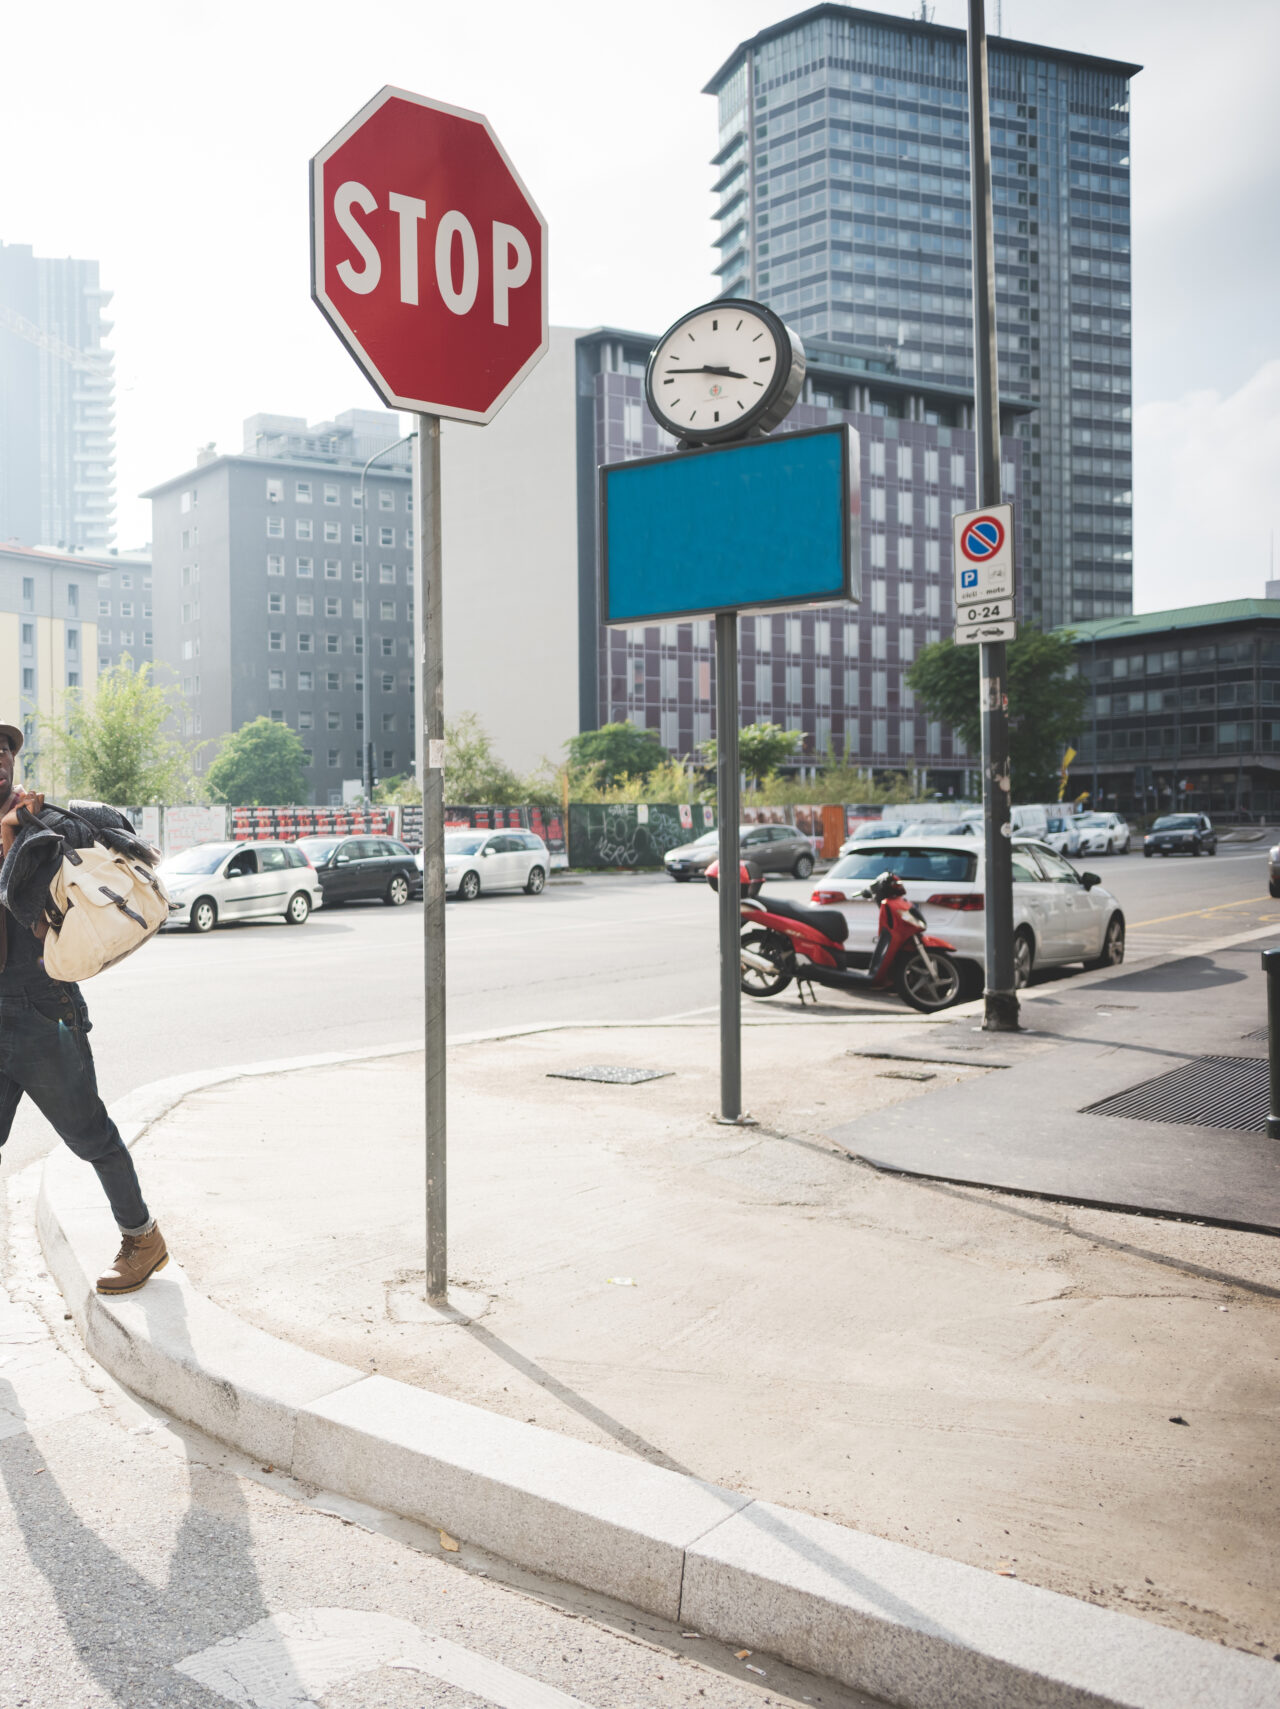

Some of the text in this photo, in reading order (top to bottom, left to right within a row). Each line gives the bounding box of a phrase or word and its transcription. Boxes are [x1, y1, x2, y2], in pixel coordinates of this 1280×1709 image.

[333, 180, 532, 327] STOP
[964, 572, 976, 587] P
[986, 587, 1006, 595] moto
[967, 605, 1001, 620] 0-24
